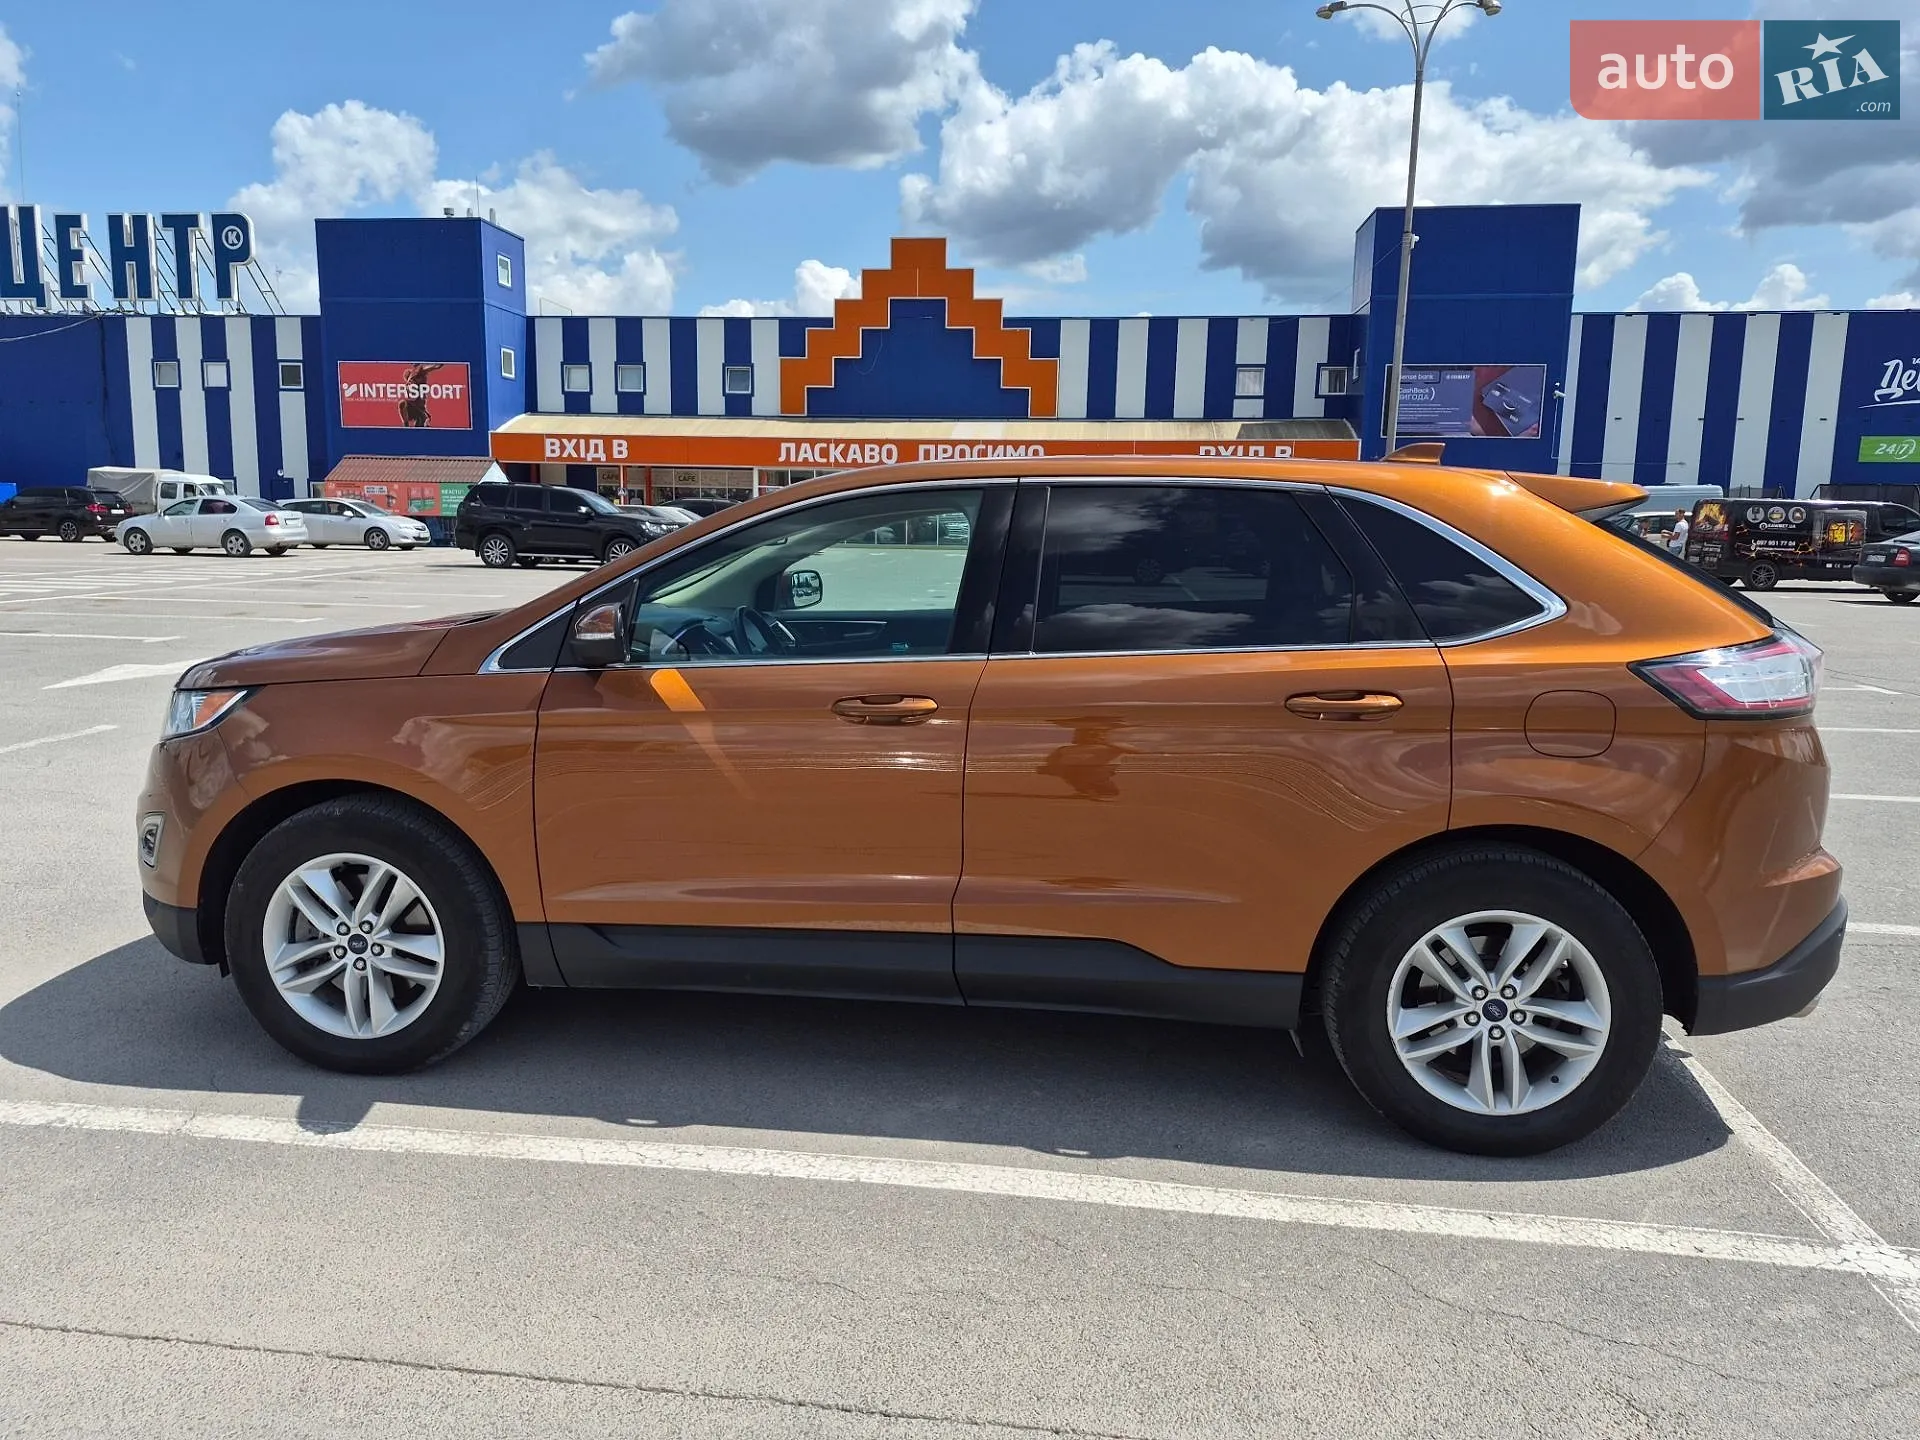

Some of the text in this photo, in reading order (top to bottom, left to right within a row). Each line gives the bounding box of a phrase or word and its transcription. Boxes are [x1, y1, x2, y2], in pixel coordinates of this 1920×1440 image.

[0, 203, 256, 310] ЦЕНТР
[359, 383, 465, 399] INTERSPORT
[1874, 359, 1920, 402] Де
[545, 438, 629, 462] ВХІД В
[778, 442, 1045, 465] ЛАСКАВО ПРОСИМО
[678, 473, 696, 482] CAFE
